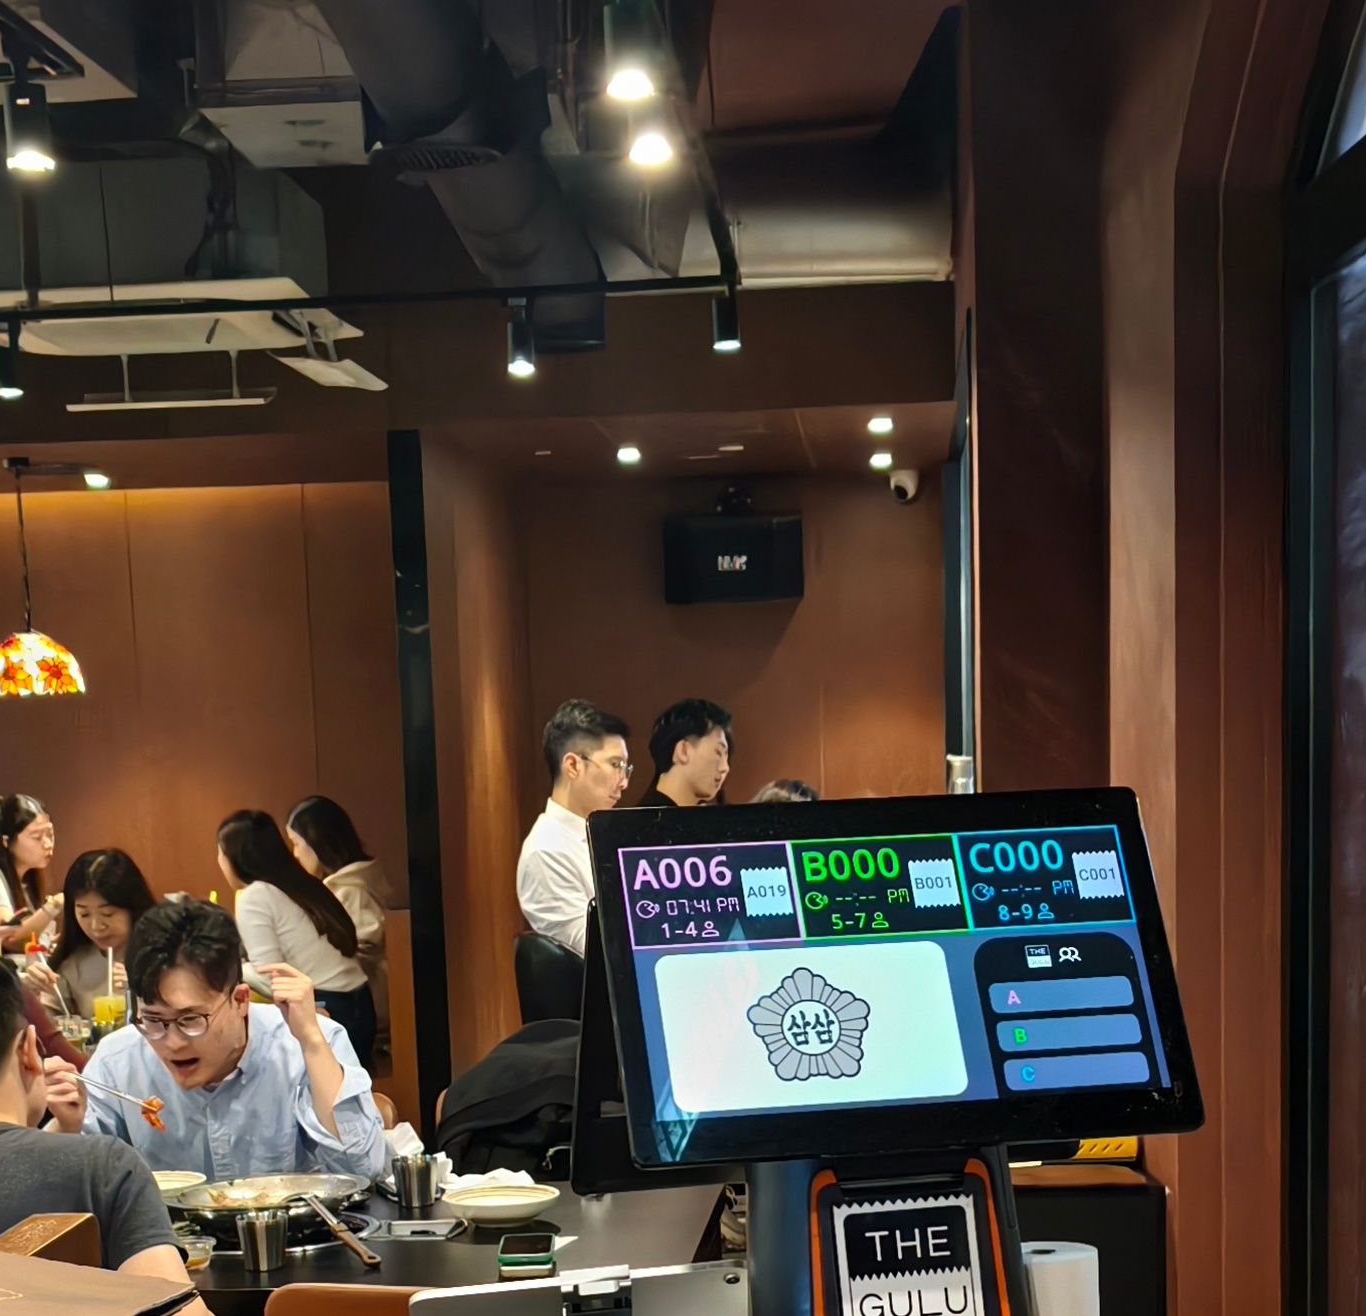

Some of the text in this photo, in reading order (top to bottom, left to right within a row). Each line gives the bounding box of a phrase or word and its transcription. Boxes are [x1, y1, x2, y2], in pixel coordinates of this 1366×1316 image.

[802, 848, 900, 881] B000
[969, 840, 1064, 873] C000
[634, 855, 732, 890] A006
[1079, 868, 1116, 881] C001
[915, 876, 953, 889] B001
[1052, 880, 1074, 894] PM
[747, 884, 786, 898] A019
[887, 888, 910, 903] PM
[716, 897, 740, 912] PM
[998, 903, 1033, 921] 8-9
[832, 912, 866, 929] 5-7
[661, 921, 698, 938] 1-4
[1029, 947, 1046, 955] THE
[1007, 990, 1021, 1005] A
[787, 1009, 835, 1046] 삼삼
[1013, 1027, 1028, 1044] B
[1021, 1066, 1035, 1082] C
[865, 1226, 951, 1261] THE
